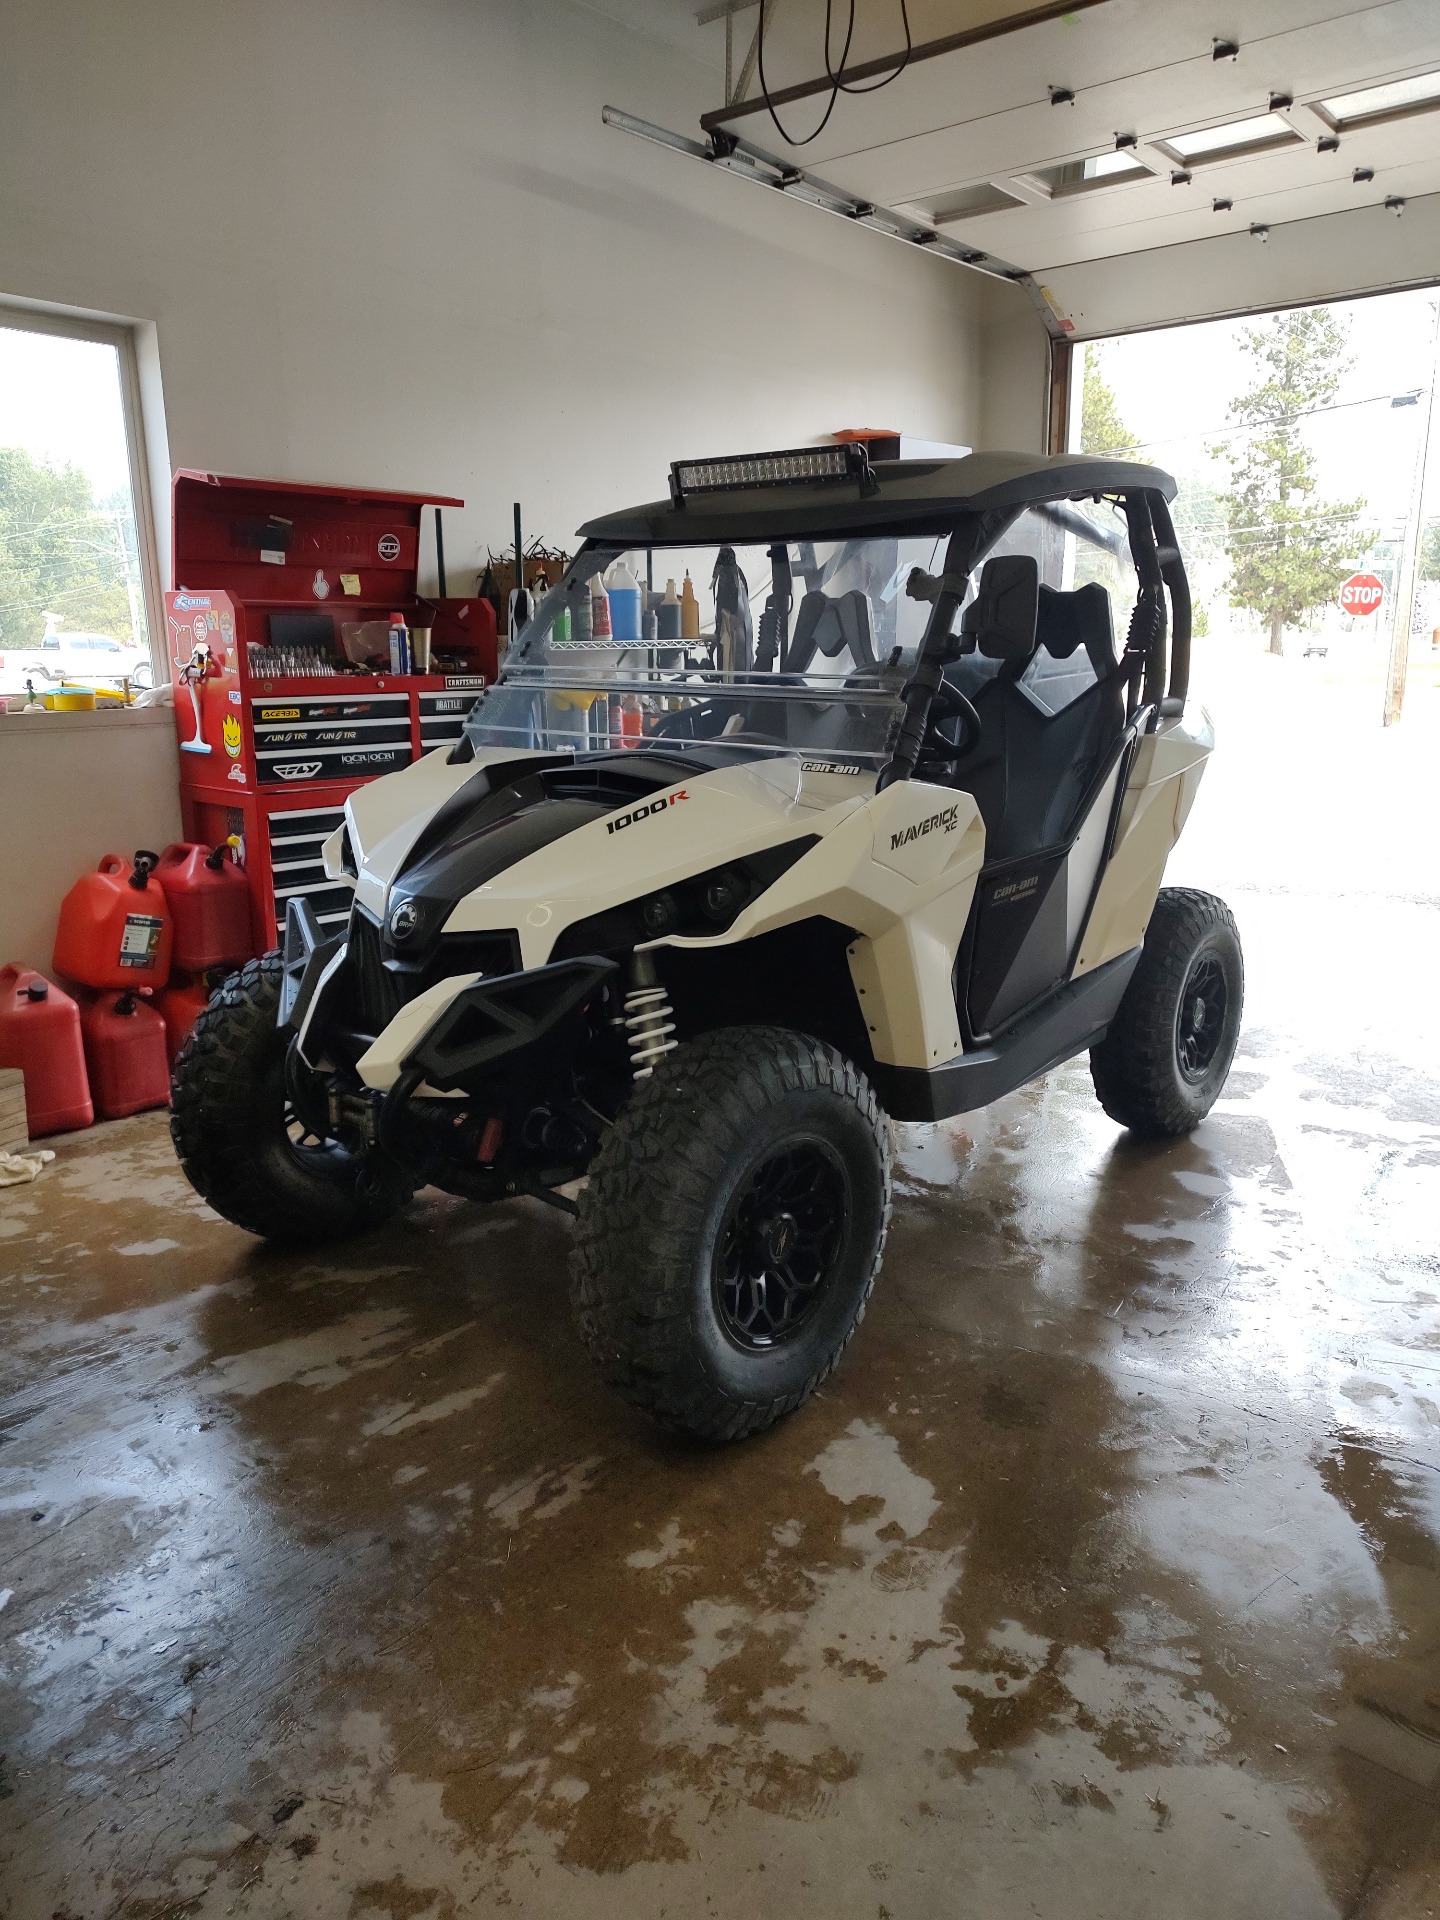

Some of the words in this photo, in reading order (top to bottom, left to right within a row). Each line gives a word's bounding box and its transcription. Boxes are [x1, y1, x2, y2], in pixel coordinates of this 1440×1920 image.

[1342, 586, 1382, 604] STOP
[448, 678, 482, 686] CRAFTSMAN
[263, 709, 299, 717] ACERBIS
[274, 764, 319, 775] FLY
[801, 761, 860, 775] can-am
[606, 790, 690, 834] 1000R
[890, 804, 959, 850] MAVERICK
[944, 820, 958, 834] XC
[994, 876, 1038, 899] can-am
